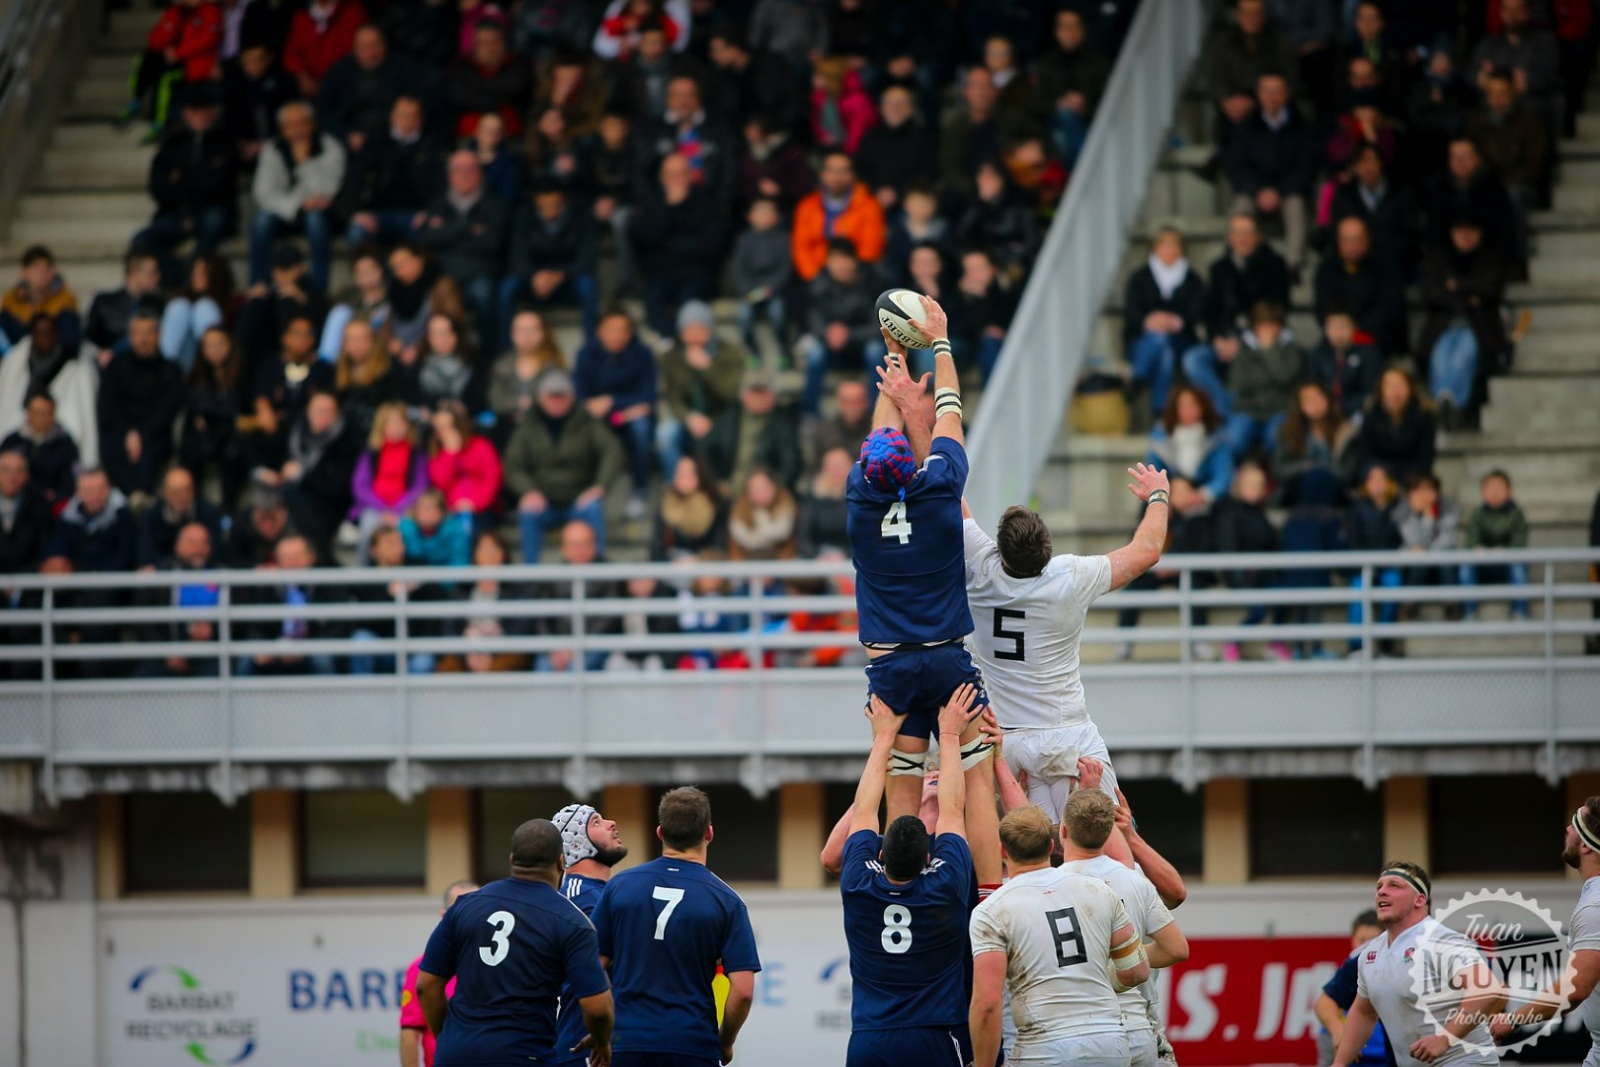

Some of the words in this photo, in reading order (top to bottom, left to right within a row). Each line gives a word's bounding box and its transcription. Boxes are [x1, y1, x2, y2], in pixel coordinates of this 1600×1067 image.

[881, 502, 912, 544] 4
[993, 608, 1026, 661] 5
[479, 911, 516, 967] 3
[652, 886, 685, 940] 7
[881, 904, 912, 953] 8
[1045, 907, 1088, 967] 8
